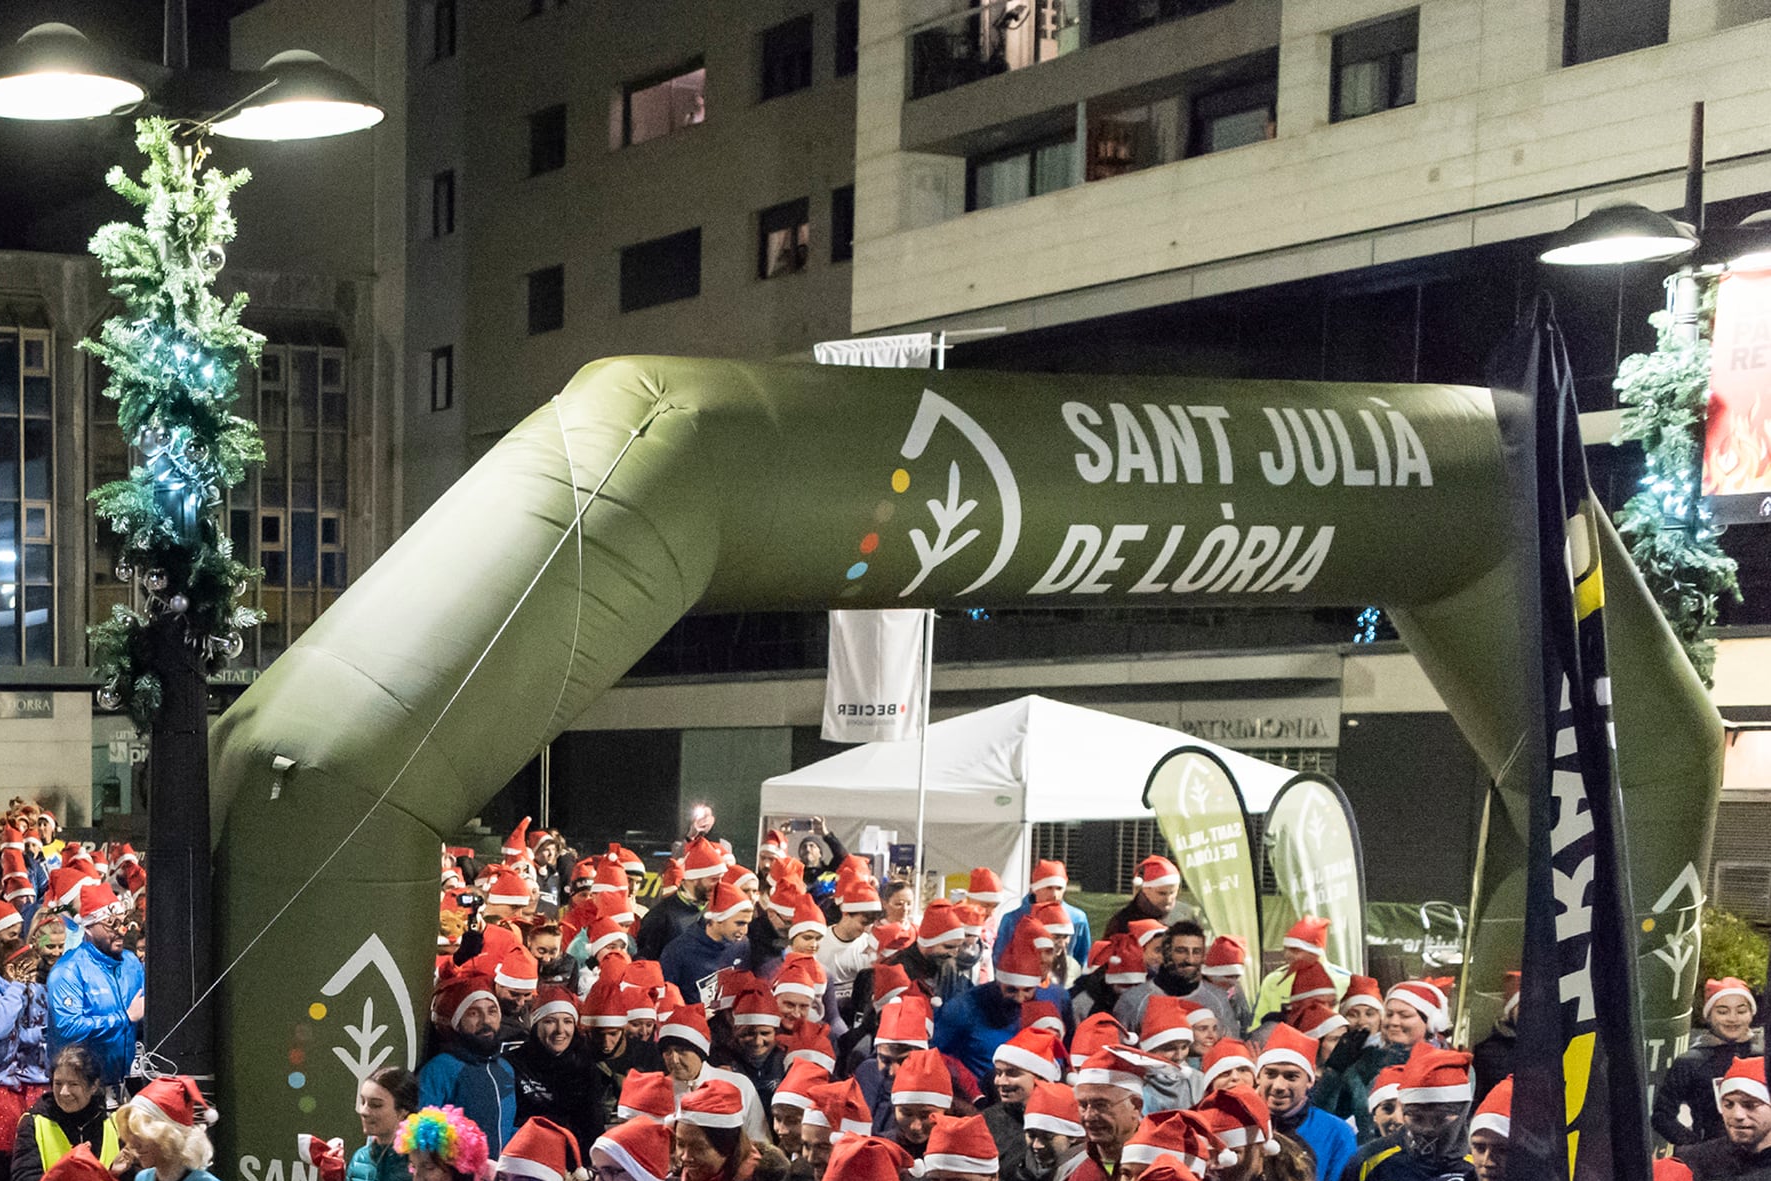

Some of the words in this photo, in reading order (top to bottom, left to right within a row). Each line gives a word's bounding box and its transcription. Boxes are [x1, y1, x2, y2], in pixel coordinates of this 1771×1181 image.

[1061, 401, 1234, 485] SANT
[1259, 395, 1434, 488] JULIÀ
[1028, 523, 1148, 596] DE
[1136, 502, 1337, 595] LÒRIA
